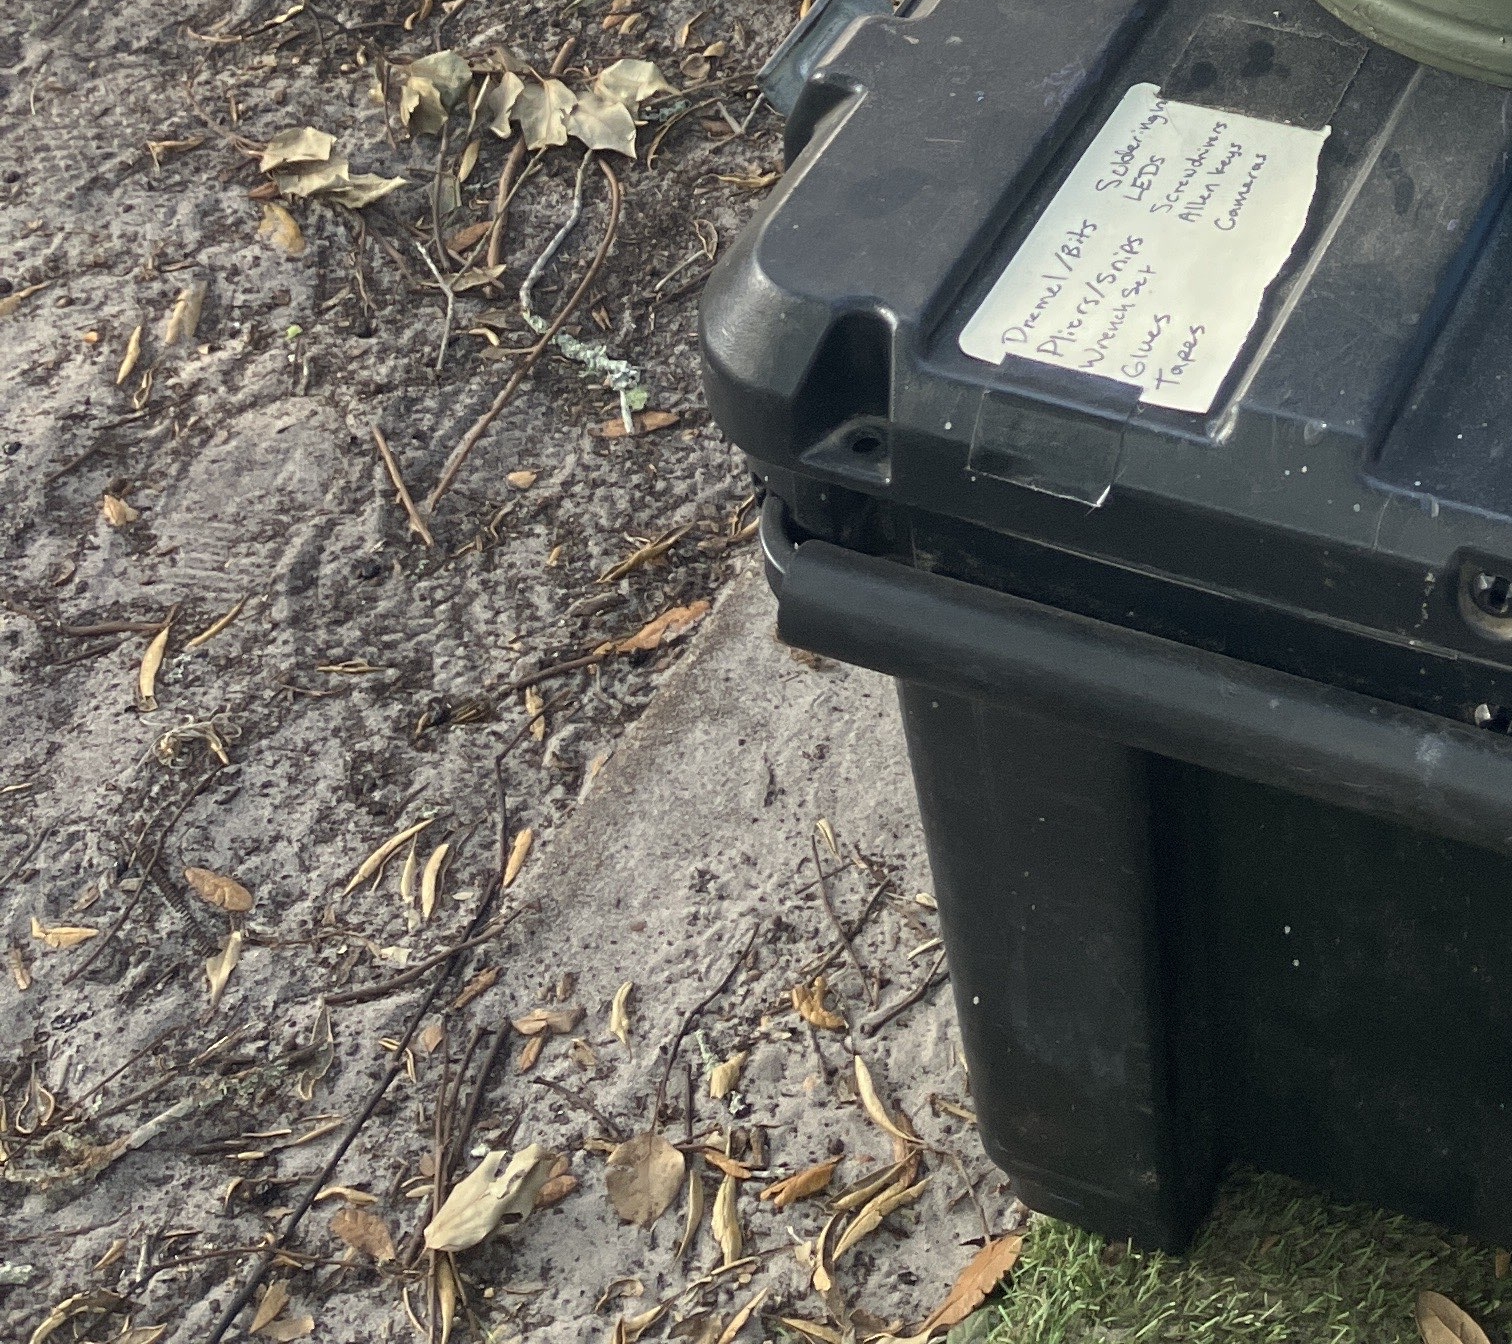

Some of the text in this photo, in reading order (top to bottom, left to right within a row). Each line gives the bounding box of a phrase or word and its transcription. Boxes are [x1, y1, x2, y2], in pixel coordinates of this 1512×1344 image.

[1177, 182, 1221, 223] Allen
[1213, 152, 1268, 231] Cameras
[1078, 302, 1136, 368] Wrench
[1121, 313, 1171, 378] Glues
[1155, 323, 1206, 391] Tapes
